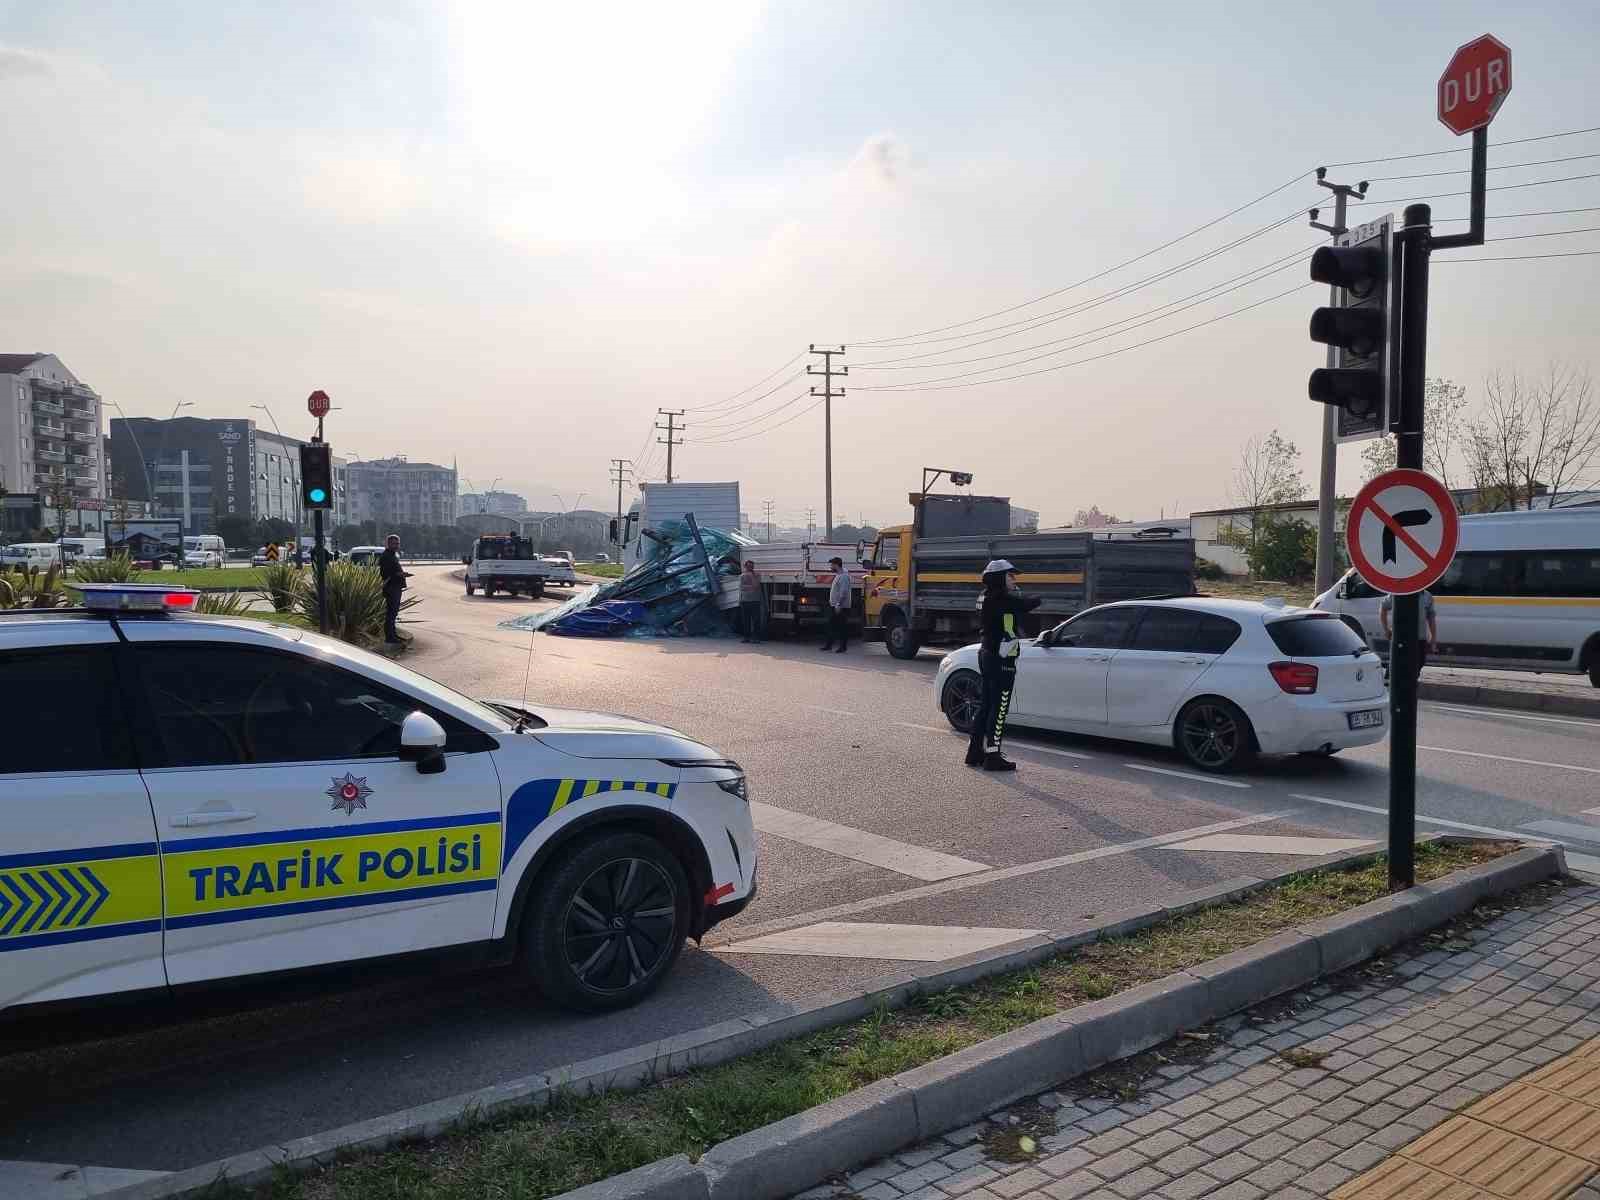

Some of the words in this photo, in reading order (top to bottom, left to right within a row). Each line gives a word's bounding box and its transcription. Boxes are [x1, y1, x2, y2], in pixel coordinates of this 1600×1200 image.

[1443, 58, 1504, 113] DUR
[309, 399, 328, 410] DUR
[189, 849, 344, 901] TRAFİK
[358, 833, 481, 882] POLİSİ
